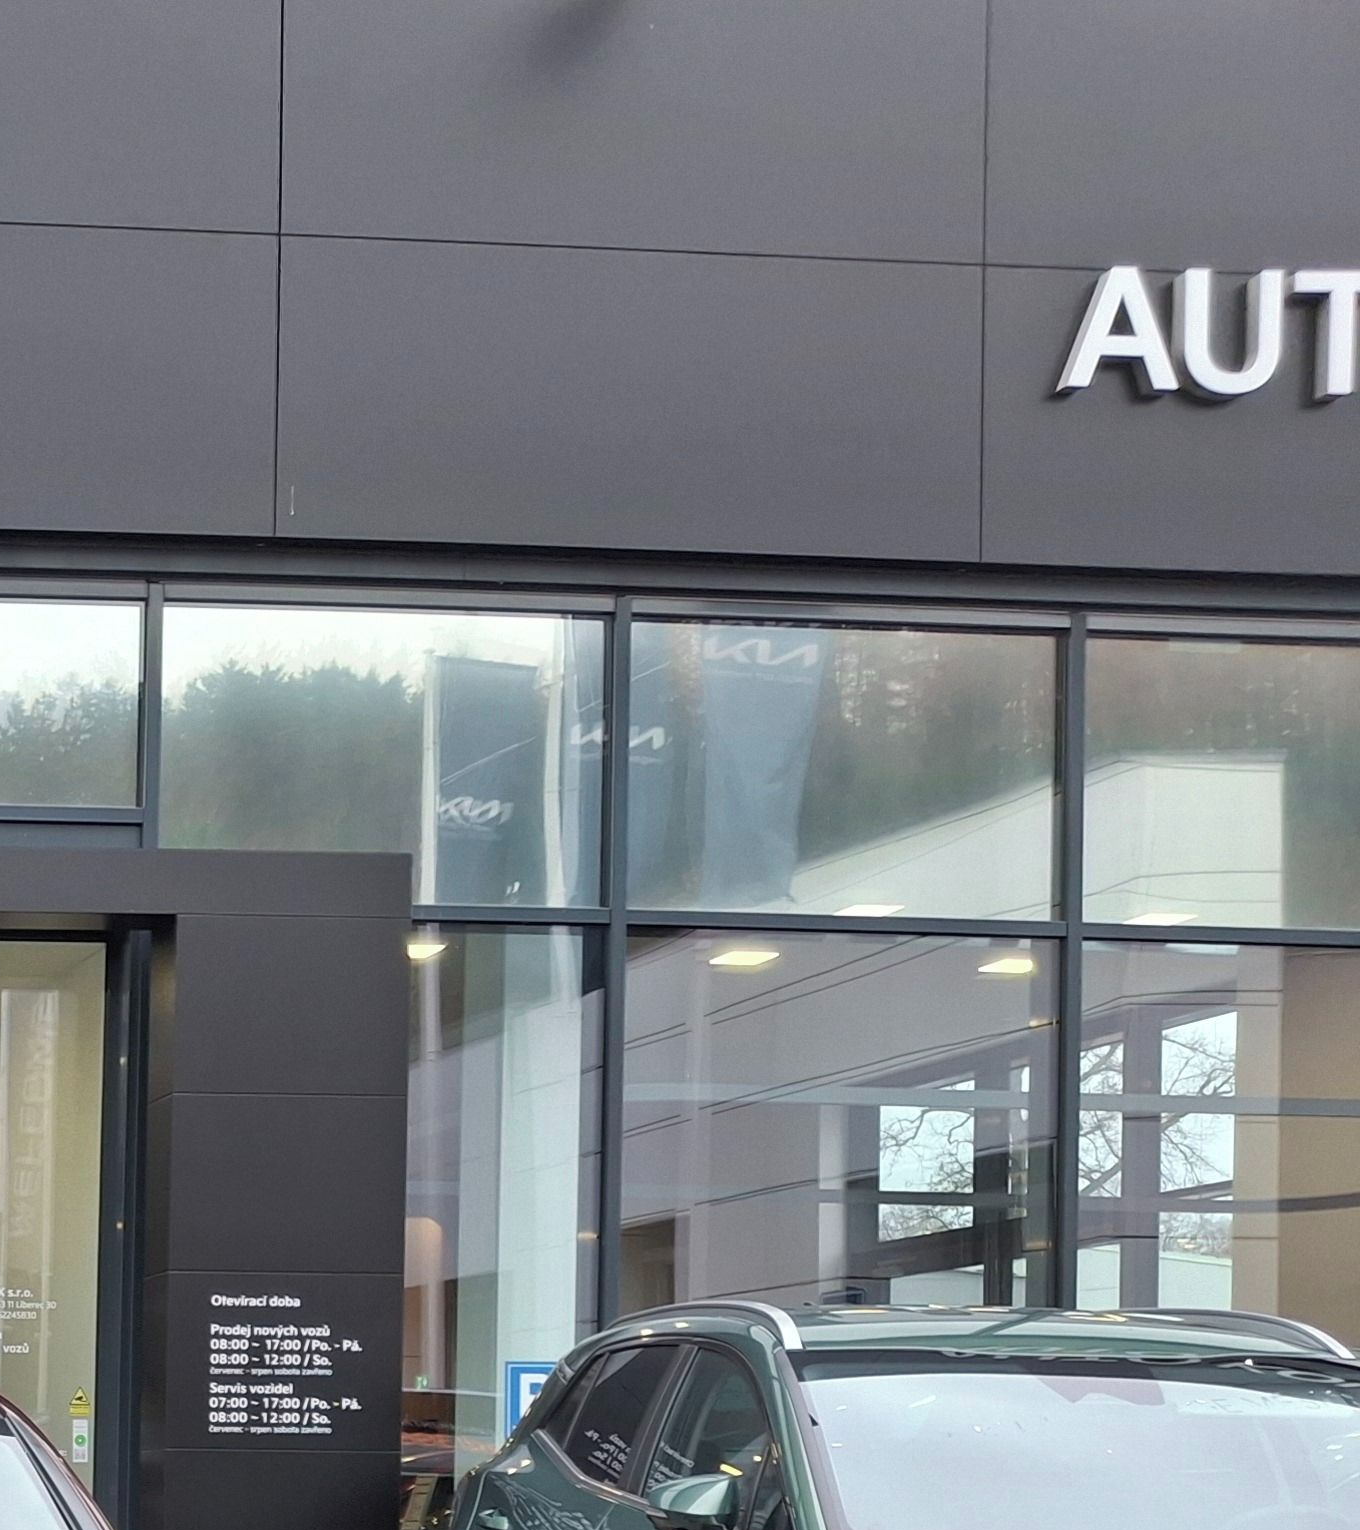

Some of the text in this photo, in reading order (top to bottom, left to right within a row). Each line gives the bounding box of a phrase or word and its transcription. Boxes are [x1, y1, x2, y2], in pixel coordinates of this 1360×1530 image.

[1056, 265, 1360, 400] AUT
[7, 1288, 34, 1298] s.r.o.
[210, 1295, 301, 1308] Otevírací doba
[210, 1323, 331, 1338] Prodej nových vozů
[2, 1342, 30, 1354] vozů
[209, 1338, 249, 1351] 08:00
[265, 1339, 302, 1351] 17:00
[209, 1353, 249, 1365] 08:00
[264, 1354, 302, 1365] 12:00
[312, 1354, 333, 1366] So.
[209, 1382, 294, 1395] Servis vozidel
[208, 1397, 248, 1409] 07:00
[262, 1397, 301, 1409] 17:00
[208, 1412, 248, 1423] 08:00
[261, 1412, 301, 1424] 12:00
[311, 1412, 332, 1424] So.
